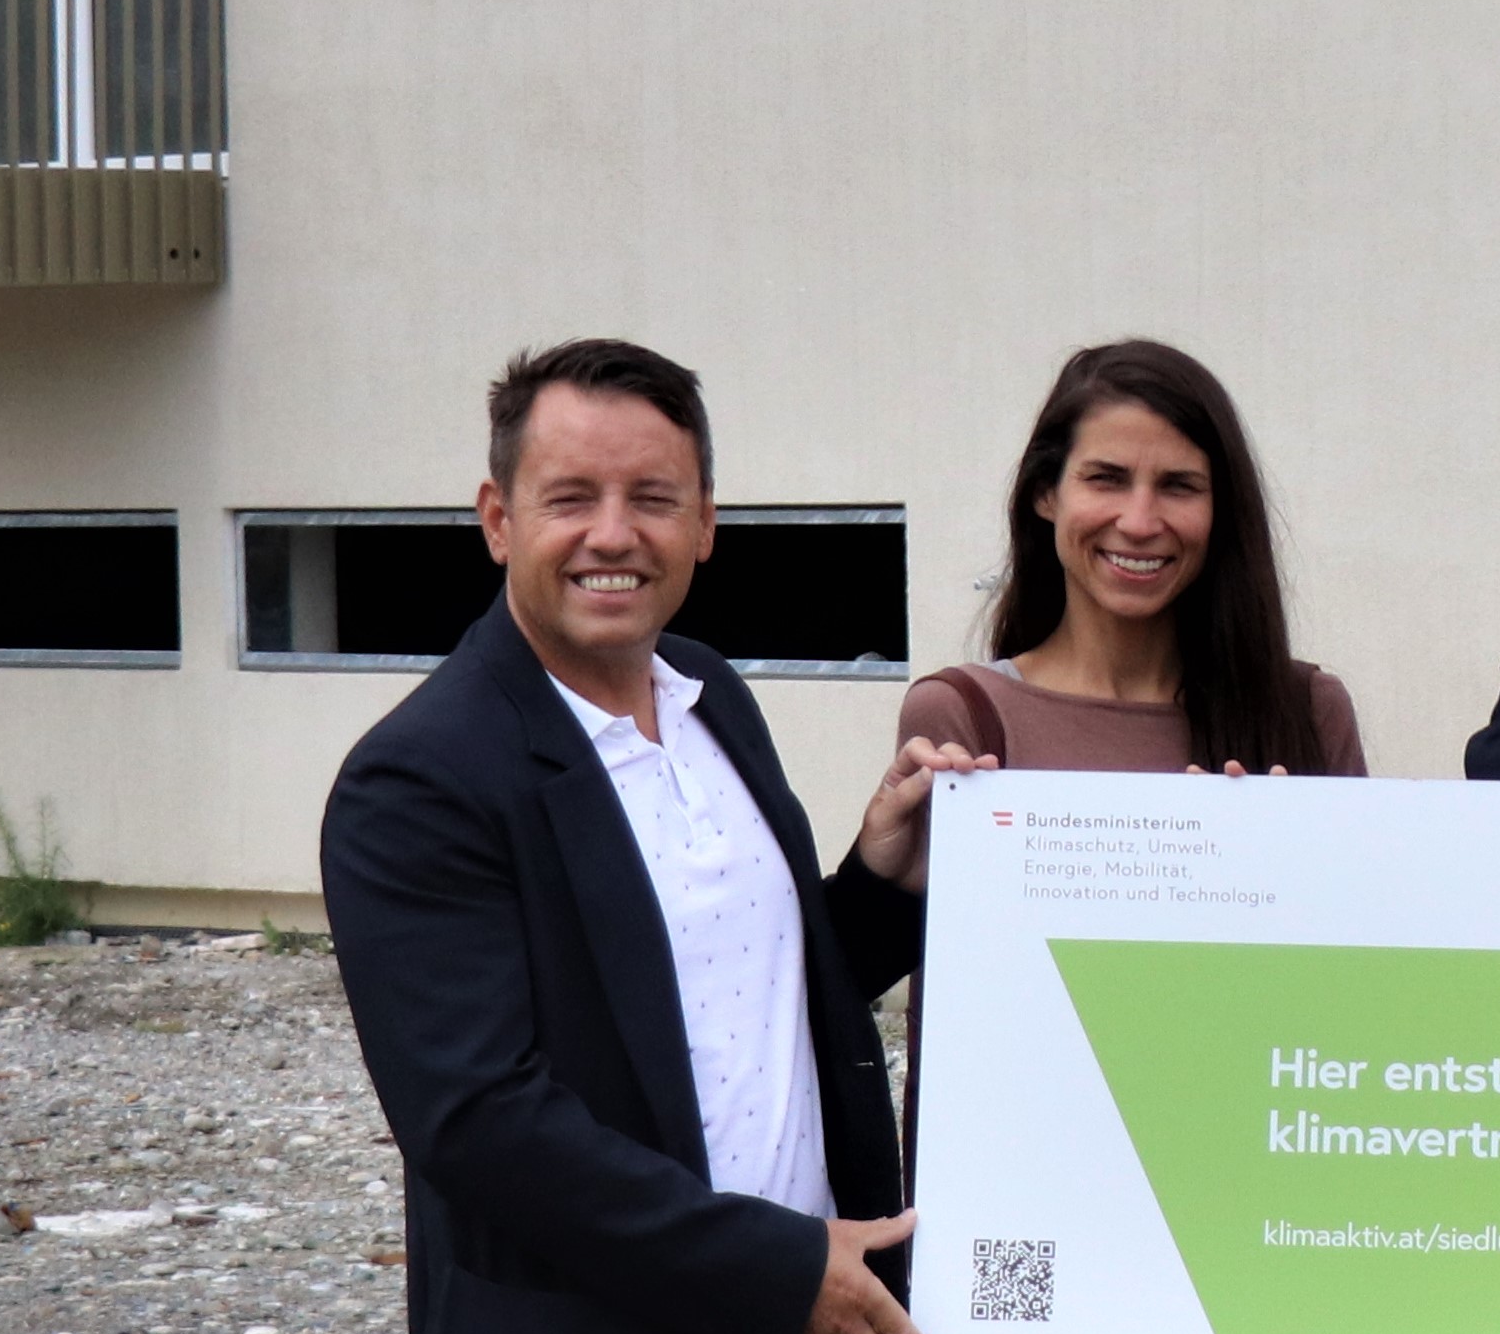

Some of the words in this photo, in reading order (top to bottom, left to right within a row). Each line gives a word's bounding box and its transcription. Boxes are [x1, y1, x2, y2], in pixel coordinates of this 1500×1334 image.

[1025, 811, 1202, 832] Bundesministerium
[1024, 835, 1141, 857] Klimaschutz,
[1147, 838, 1223, 858] Umwelt,
[1023, 859, 1098, 880] Energie,
[1104, 860, 1194, 881] Mobilität,
[1022, 882, 1120, 901] Innovation
[1125, 885, 1160, 902] und
[1166, 885, 1277, 908] Technologie
[1269, 1046, 1369, 1090] Hier
